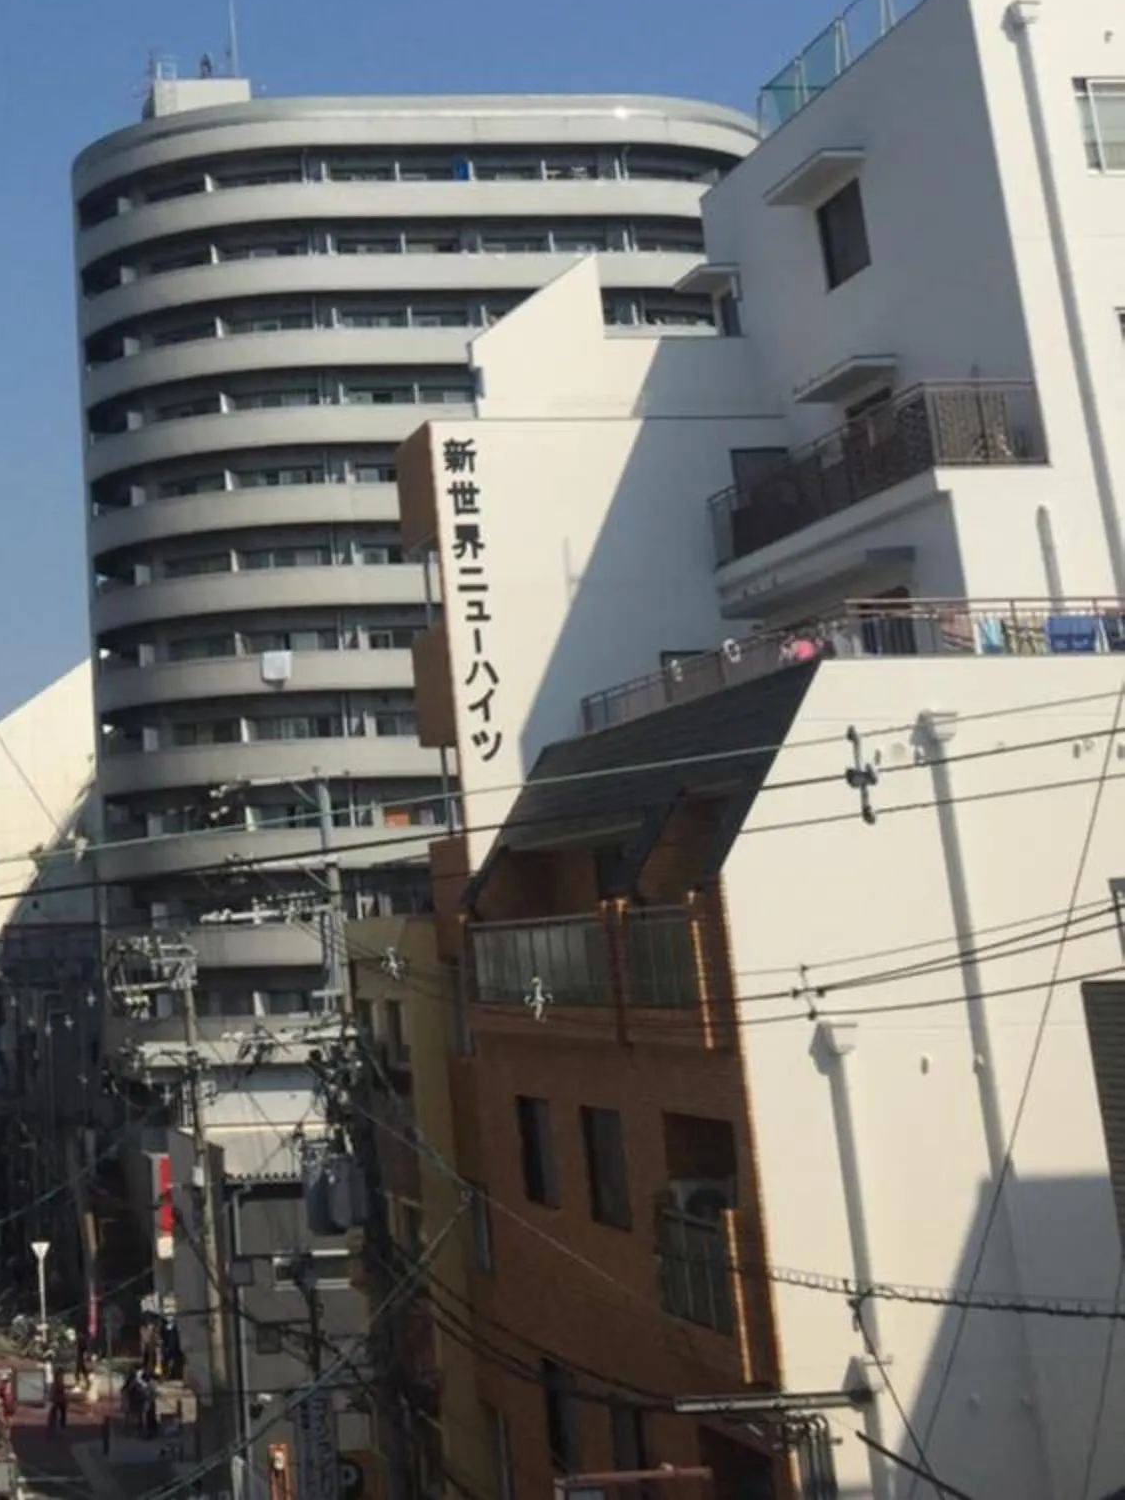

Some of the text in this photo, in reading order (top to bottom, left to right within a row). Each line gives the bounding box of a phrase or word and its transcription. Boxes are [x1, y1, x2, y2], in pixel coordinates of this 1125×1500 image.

[442, 437, 503, 762] 新世界ニューハイツ
